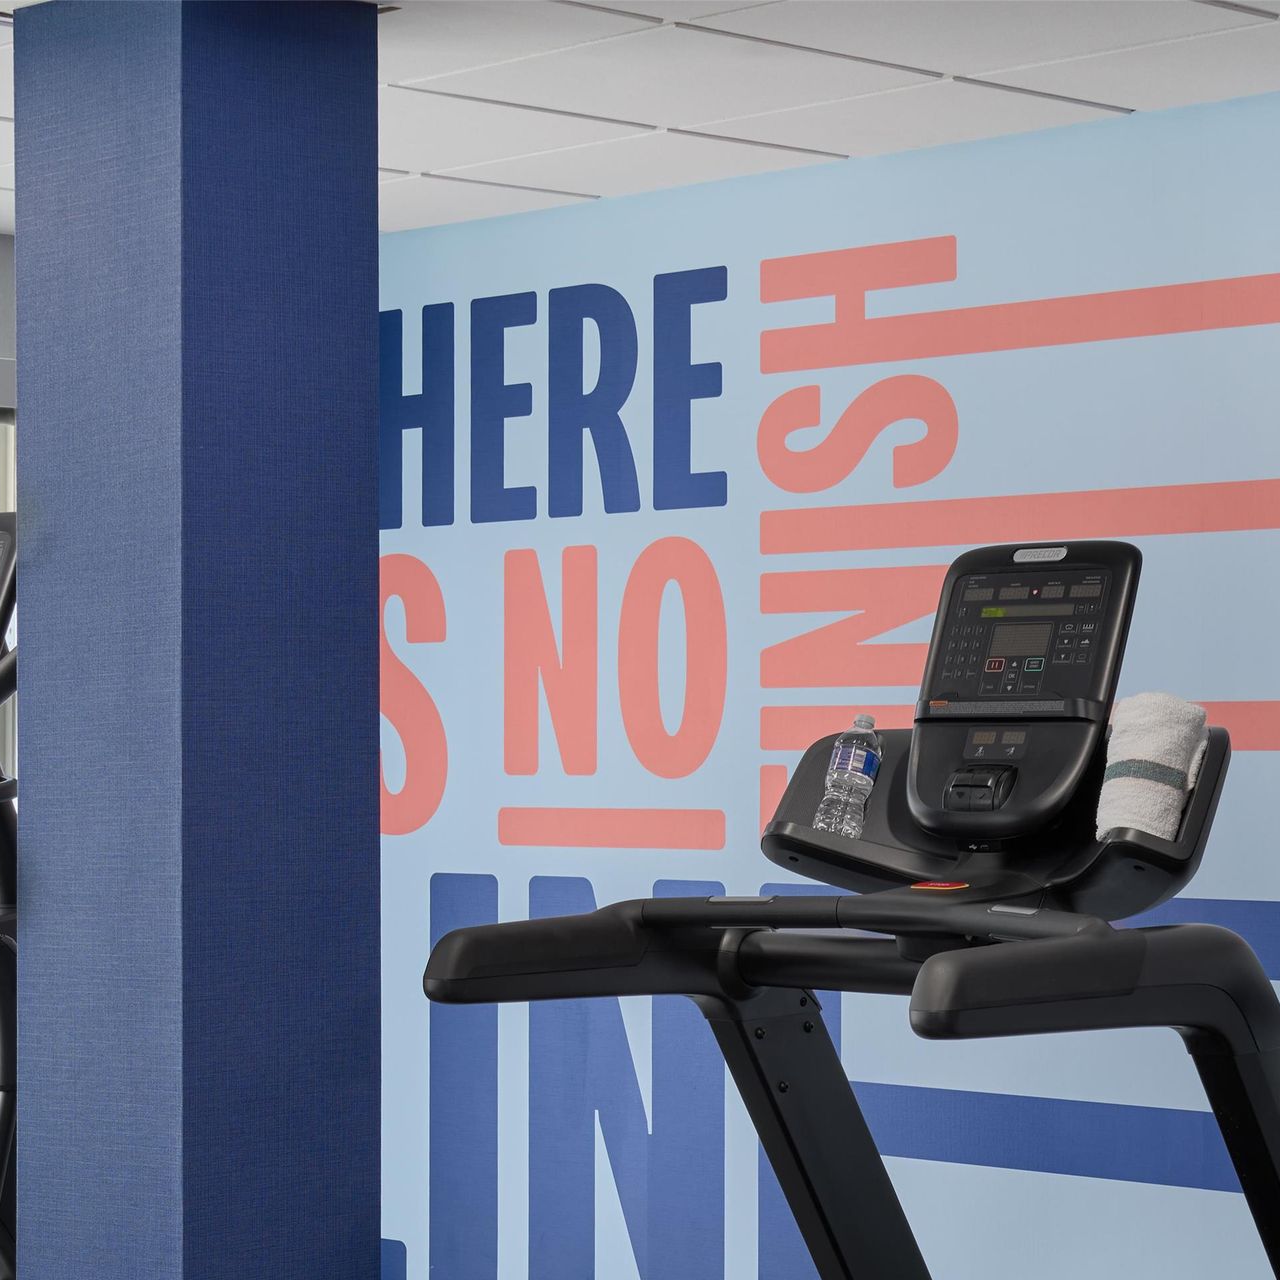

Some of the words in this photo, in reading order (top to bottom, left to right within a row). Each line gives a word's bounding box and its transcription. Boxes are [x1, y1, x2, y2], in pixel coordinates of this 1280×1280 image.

[503, 535, 728, 780] NO
[757, 234, 959, 846] INISH
[1021, 549, 1063, 561] PRECOR
